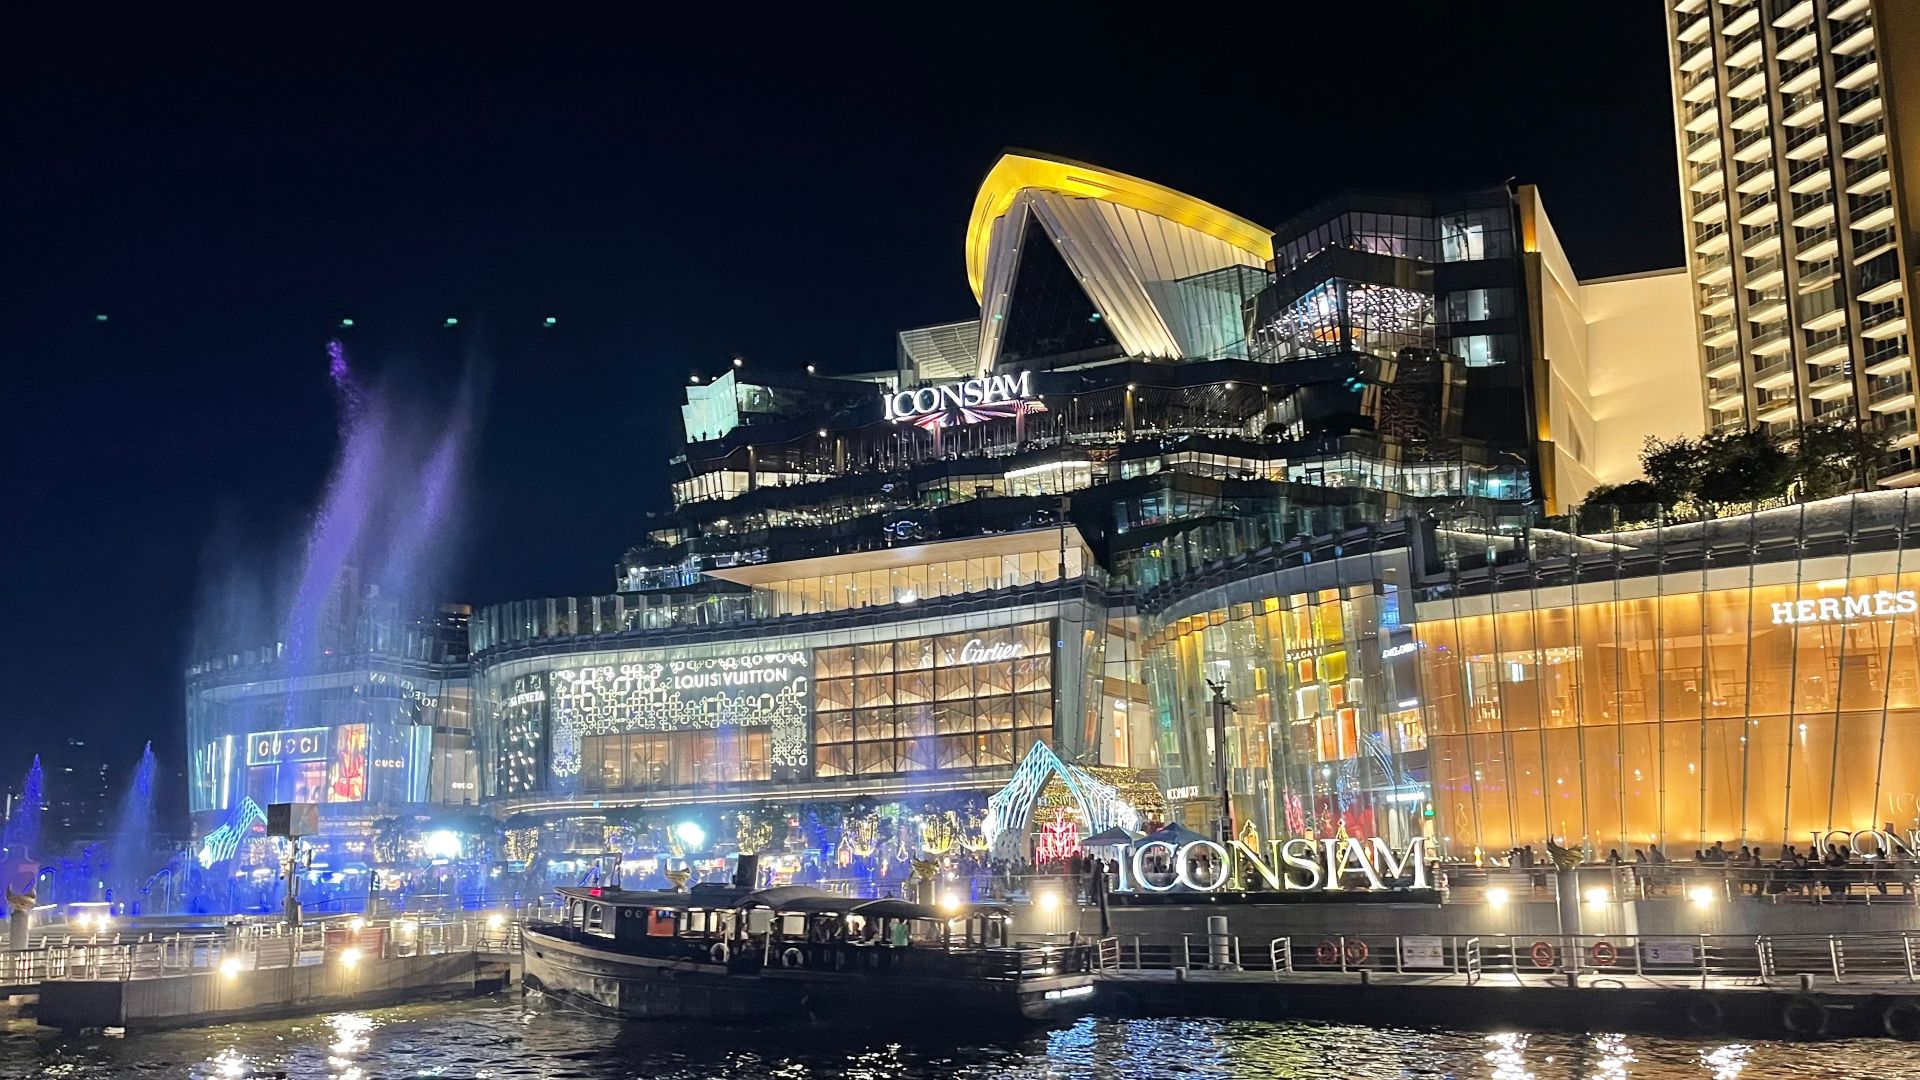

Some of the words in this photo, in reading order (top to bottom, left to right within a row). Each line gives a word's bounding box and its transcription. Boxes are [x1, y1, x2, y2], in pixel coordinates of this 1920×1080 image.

[883, 370, 1032, 420] ICONSIAM
[960, 638, 1022, 664] Cartier
[674, 673, 718, 689] LOUIS
[723, 668, 788, 686] VUITTON
[1111, 837, 1432, 893] ICONSIAM
[1650, 948, 1660, 959] 3
